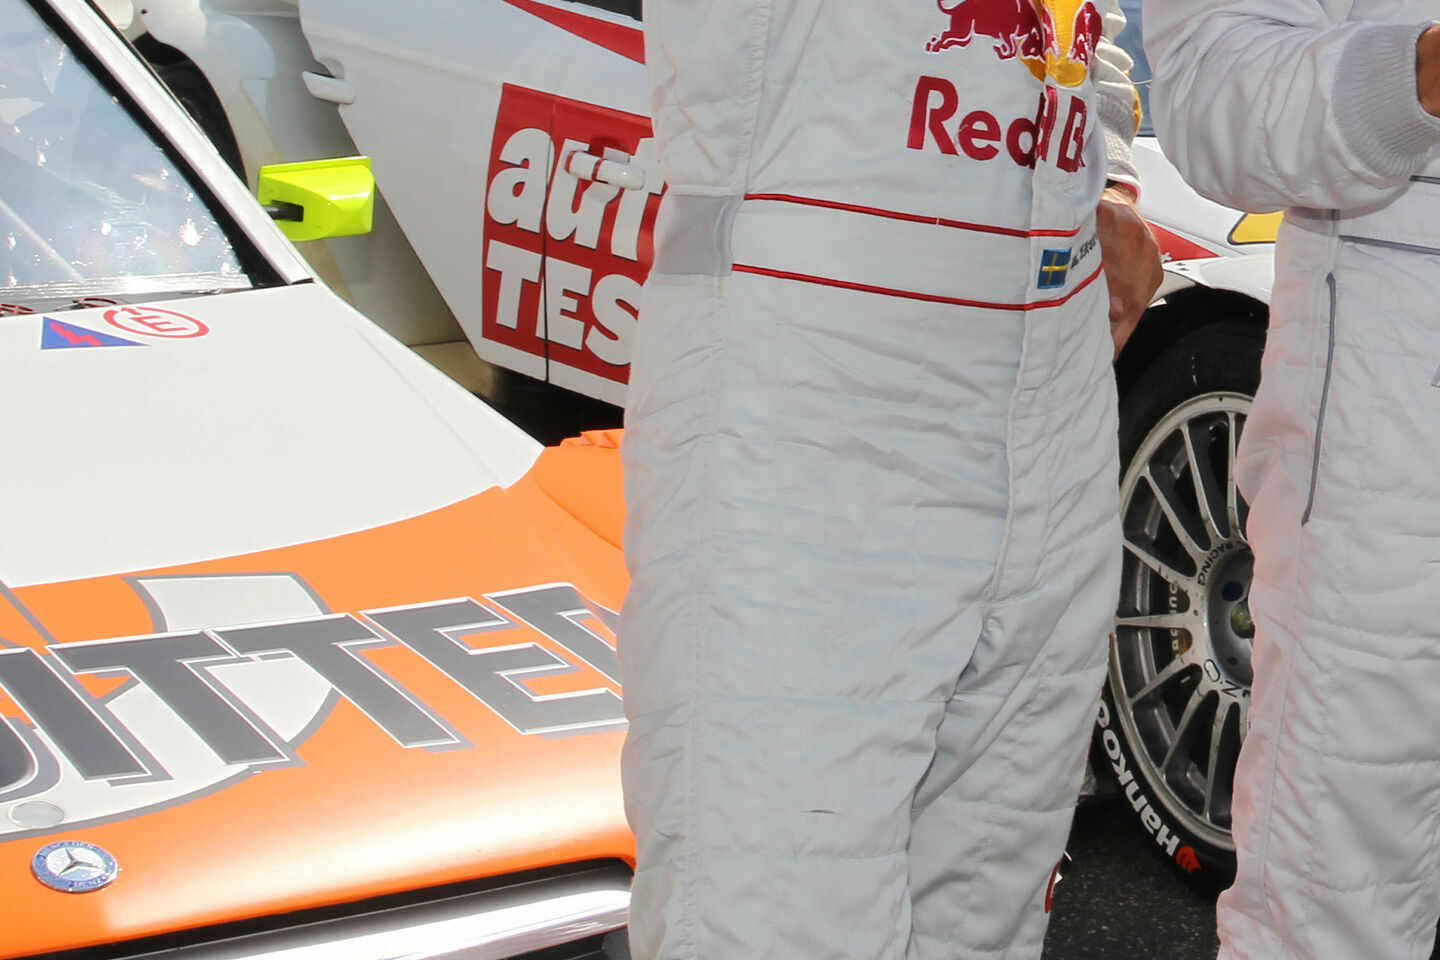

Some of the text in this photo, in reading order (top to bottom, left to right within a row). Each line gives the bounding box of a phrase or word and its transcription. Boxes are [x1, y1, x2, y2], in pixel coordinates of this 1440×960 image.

[906, 75, 1058, 170] Red
[486, 239, 641, 366] TES
[0, 581, 628, 797] ITTE
[1097, 698, 1181, 858] Hankoo
